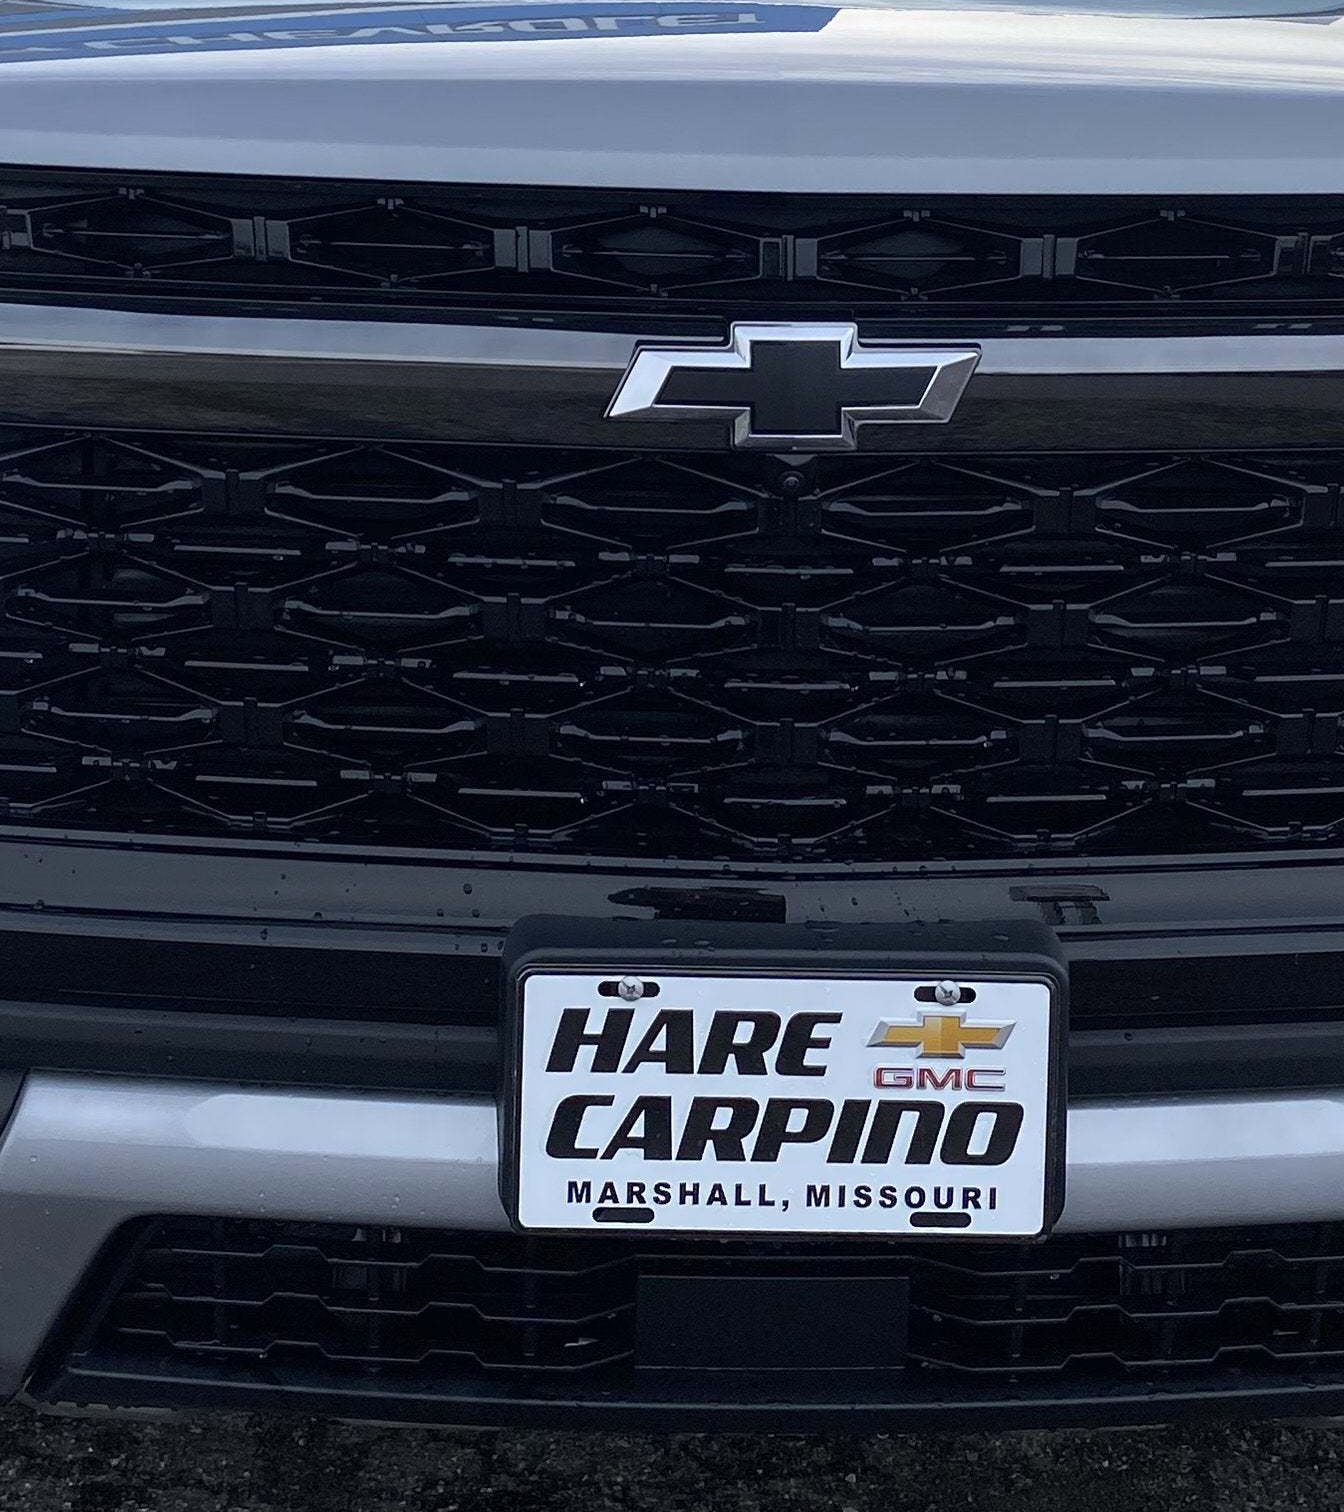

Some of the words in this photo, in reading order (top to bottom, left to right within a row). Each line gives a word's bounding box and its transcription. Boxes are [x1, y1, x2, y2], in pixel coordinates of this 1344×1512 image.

[545, 1007, 844, 1077] HARE
[873, 1065, 1008, 1092] GMC
[545, 1094, 1025, 1166] CARPINO
[566, 1180, 791, 1213] MARSHALL,
[806, 1183, 998, 1210] MISSOURI
